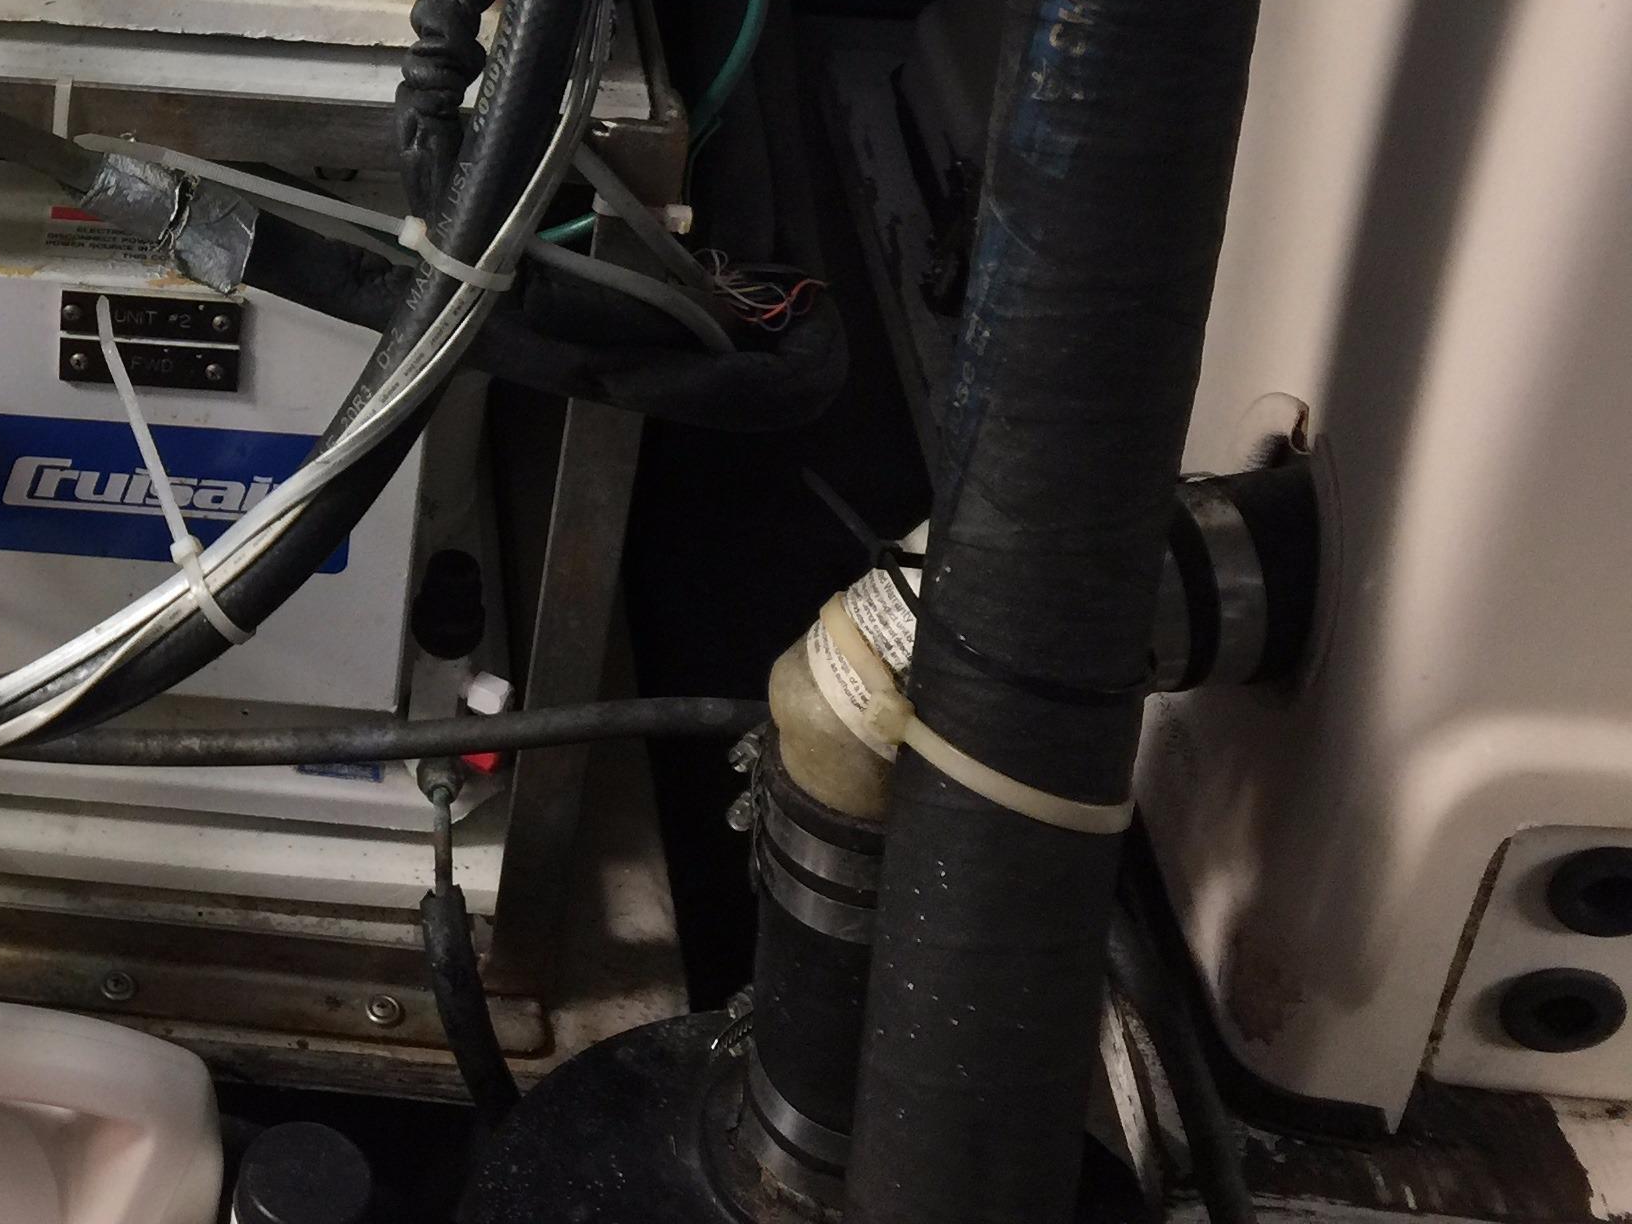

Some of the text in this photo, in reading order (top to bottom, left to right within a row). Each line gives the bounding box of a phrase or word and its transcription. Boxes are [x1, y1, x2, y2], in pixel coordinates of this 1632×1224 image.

[47, 232, 117, 242] DISCONNECT
[46, 240, 85, 249] POWER
[89, 242, 133, 251] SOURCE
[377, 327, 405, 370] D-2
[405, 260, 433, 312] MAD
[436, 215, 455, 239] IN
[449, 161, 474, 207] USA
[114, 310, 158, 325] UNIT
[2, 456, 283, 521] Cruisai
